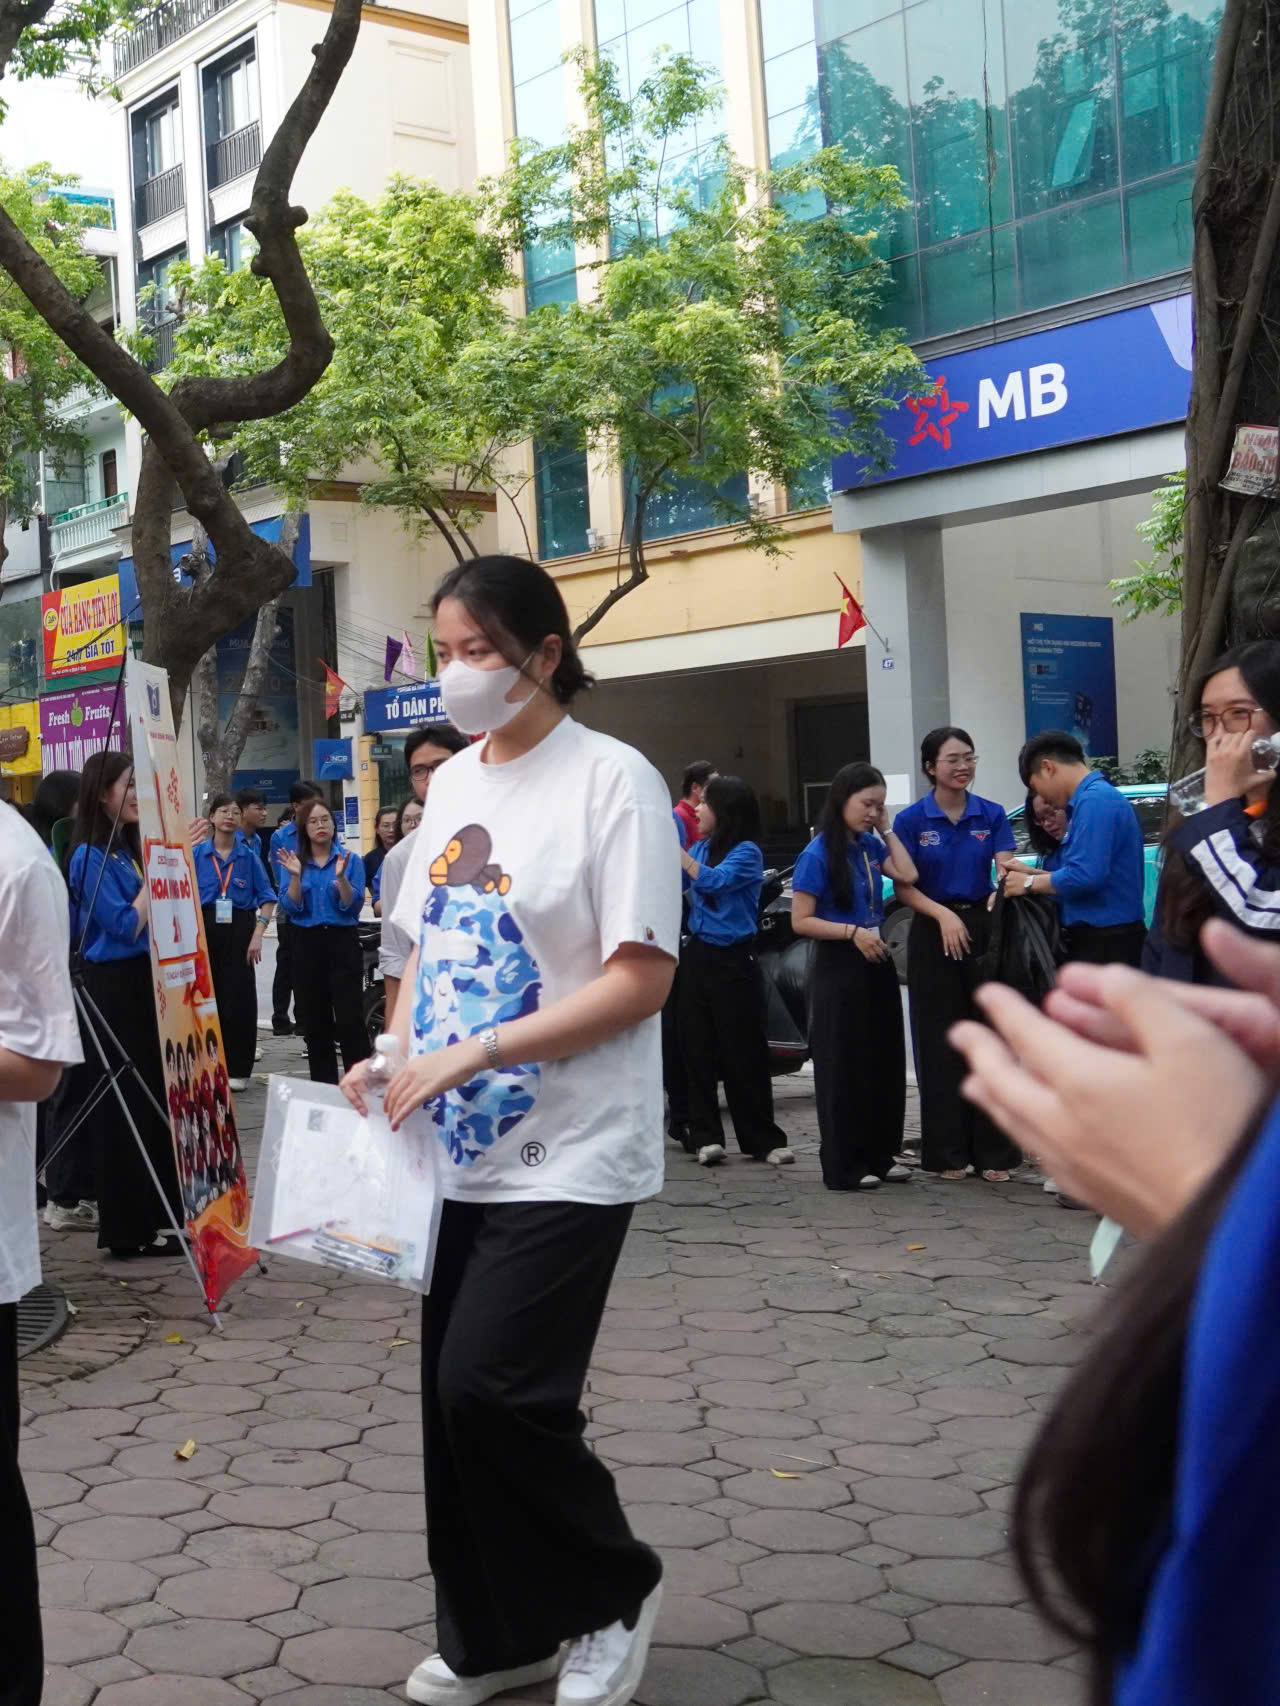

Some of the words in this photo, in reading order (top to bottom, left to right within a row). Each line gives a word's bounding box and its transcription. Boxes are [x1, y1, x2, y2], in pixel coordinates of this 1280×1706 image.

[978, 362, 1068, 429] MB
[74, 594, 91, 634] HÀNG
[85, 641, 99, 659] GIÁ
[101, 638, 115, 655] TỐT
[48, 710, 70, 727] Fresh
[385, 695, 400, 720] TỔ
[402, 696, 427, 718] DÂN
[430, 697, 447, 714] PH
[150, 877, 169, 900] HOA
